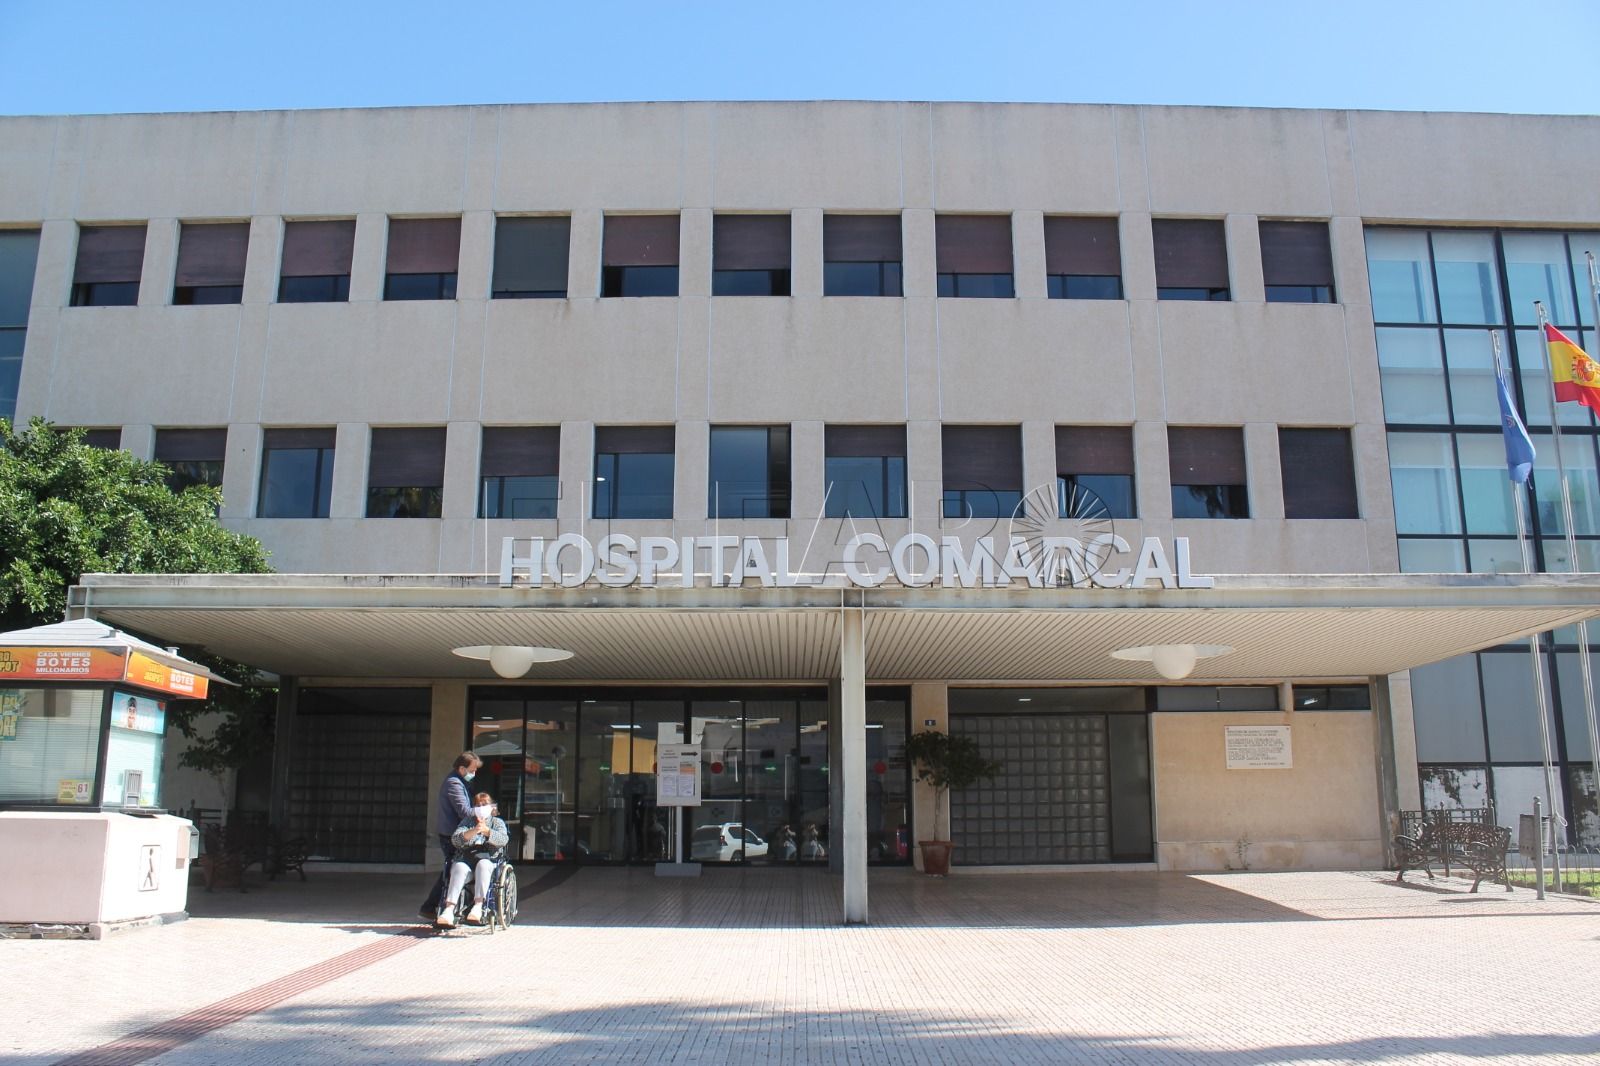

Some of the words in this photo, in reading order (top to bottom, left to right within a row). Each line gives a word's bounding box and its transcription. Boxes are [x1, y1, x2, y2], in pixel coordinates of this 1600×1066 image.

[498, 532, 814, 588] HOSPITAL
[842, 532, 1215, 589] COMARCAL
[36, 657, 91, 667] BOTES
[170, 673, 195, 685] BOTES
